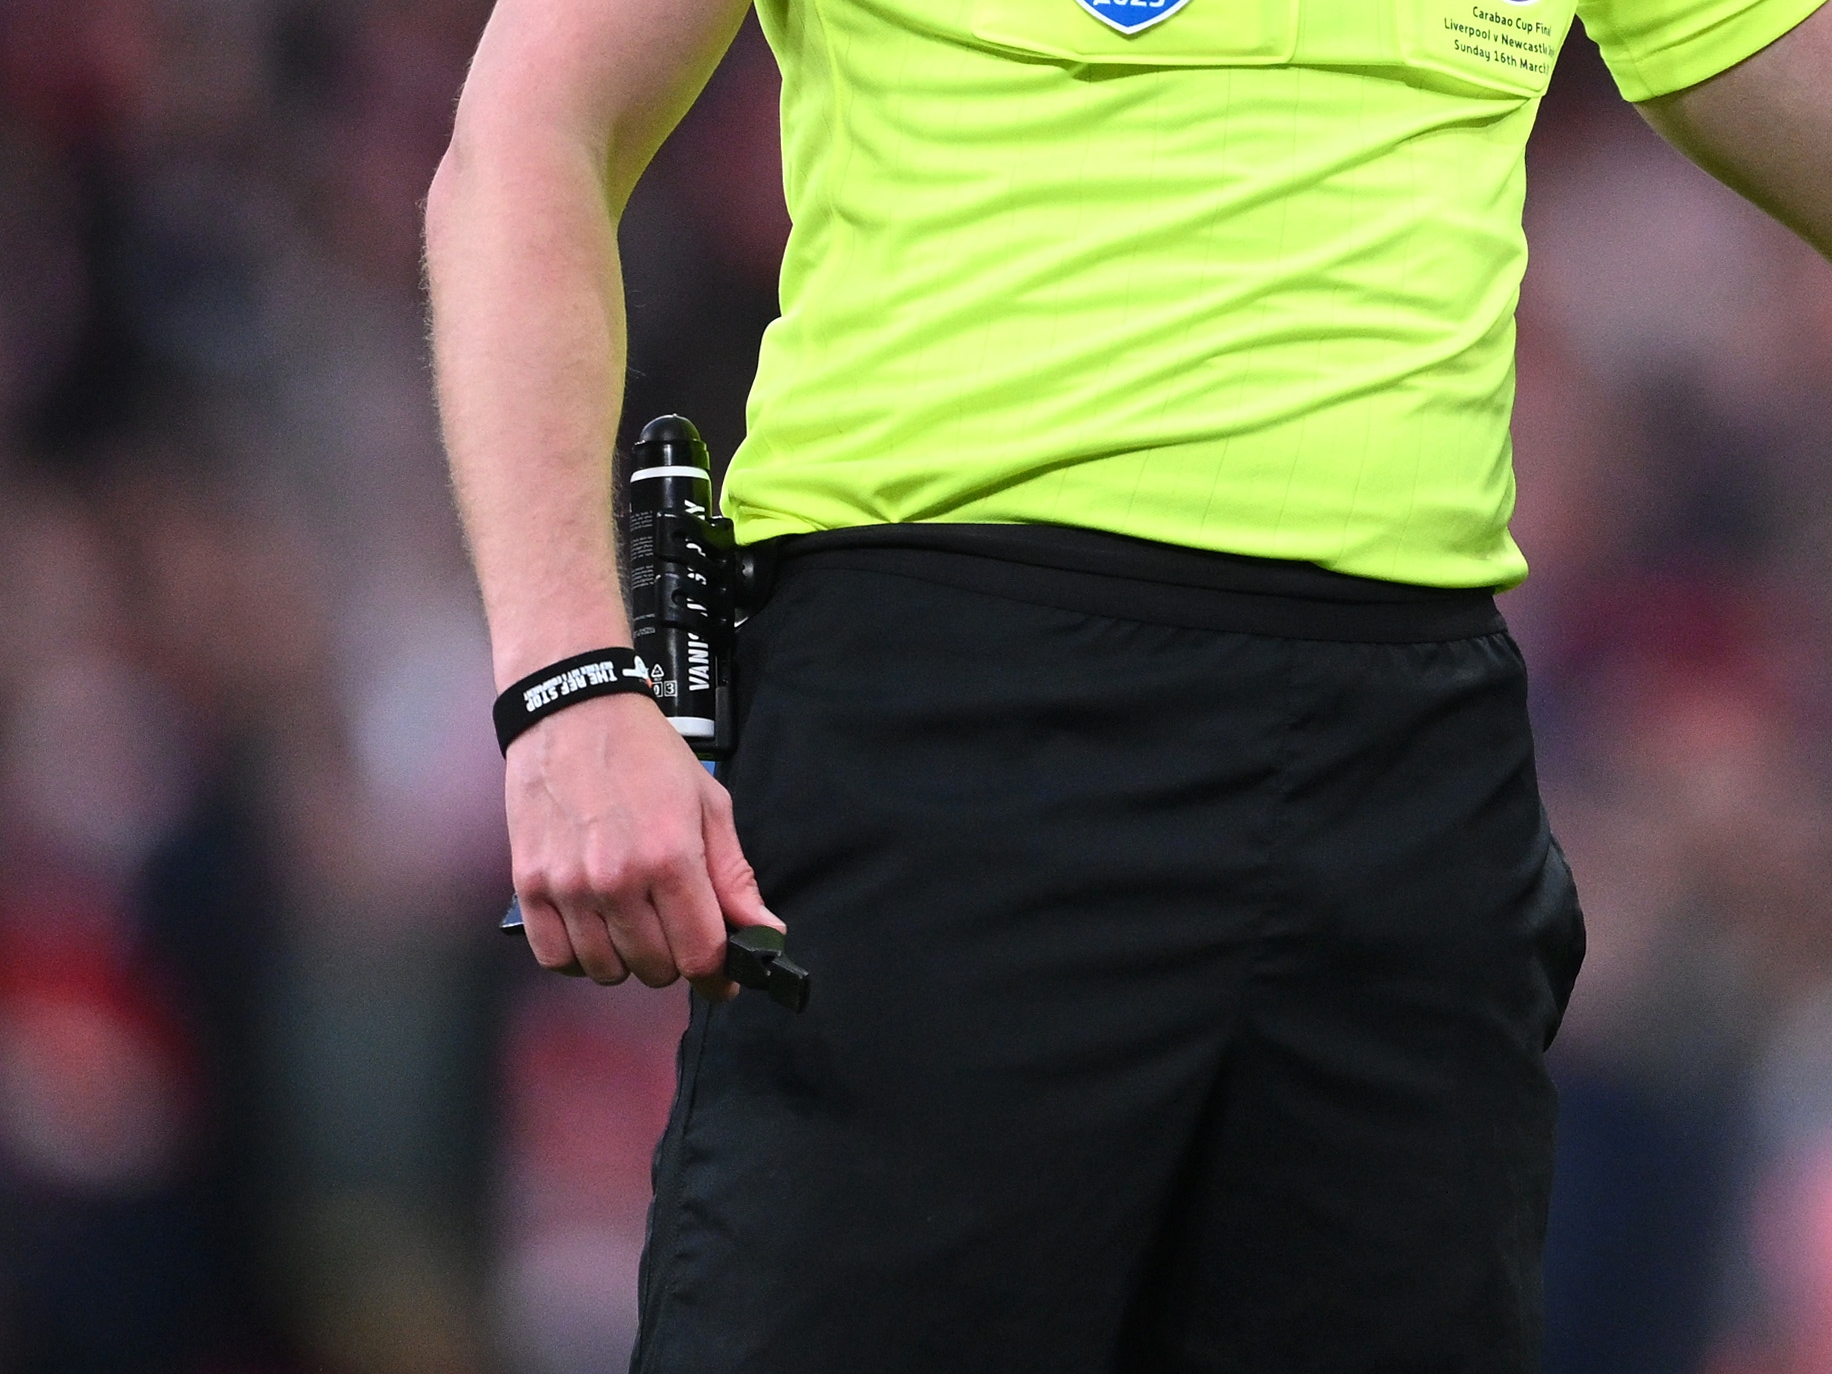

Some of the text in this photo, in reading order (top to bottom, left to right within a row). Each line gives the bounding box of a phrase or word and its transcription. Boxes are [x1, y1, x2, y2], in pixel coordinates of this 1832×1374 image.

[1444, 17, 1491, 40] Liverpool
[1472, 6, 1513, 27] Carabao
[1515, 17, 1533, 34] Cup
[1454, 39, 1491, 62] Sunday
[1494, 50, 1517, 67] 16th
[526, 684, 559, 713] STOP
